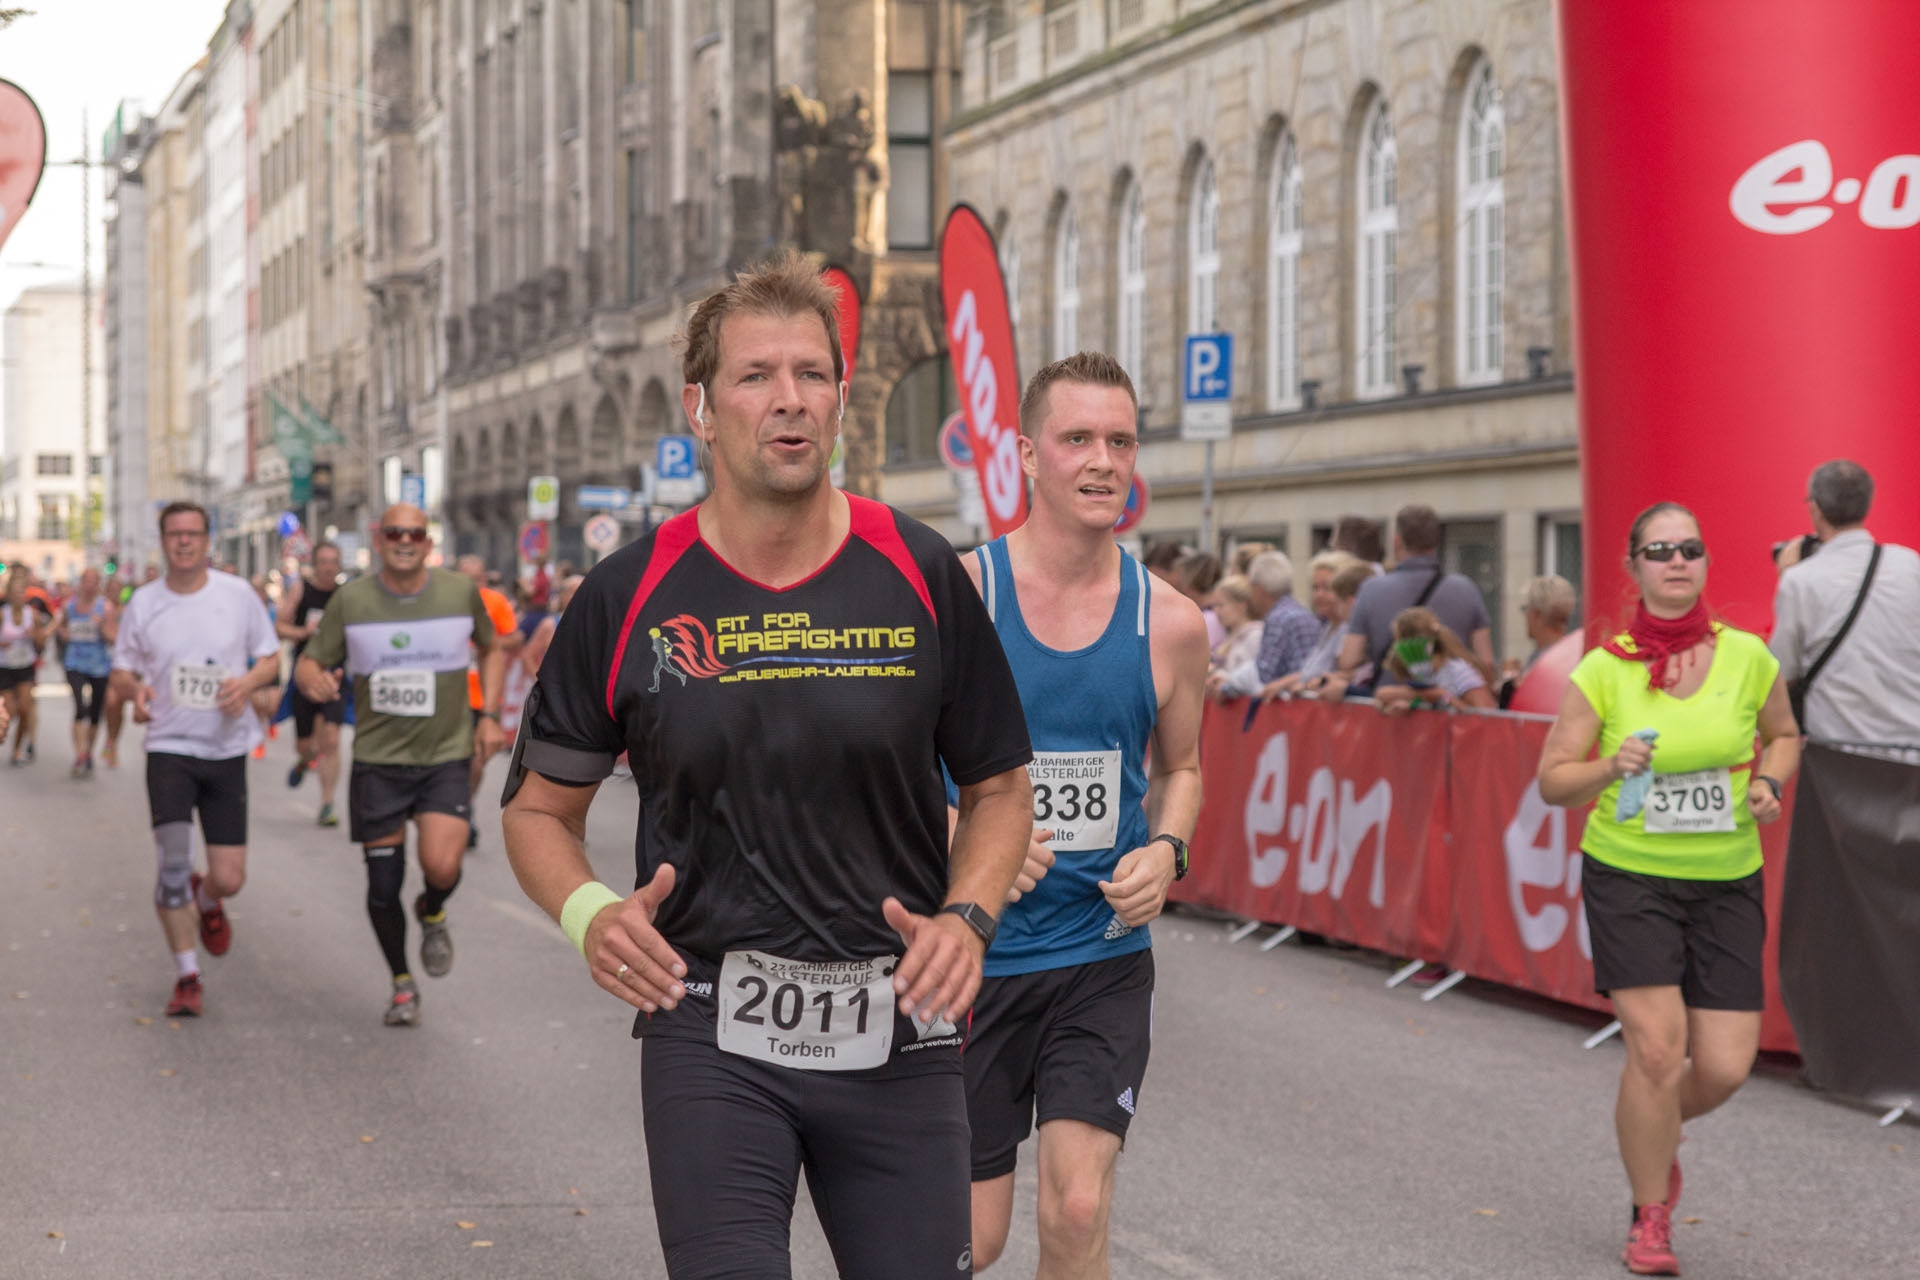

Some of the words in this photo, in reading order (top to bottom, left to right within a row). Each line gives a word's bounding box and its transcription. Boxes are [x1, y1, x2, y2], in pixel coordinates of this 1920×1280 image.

[1190, 340, 1220, 396] P
[661, 440, 687, 476] P
[716, 615, 750, 633] FIT
[763, 612, 811, 629] FOR
[718, 626, 915, 655] FIREFIGHTING
[1028, 767, 1104, 779] ALSTERLAUF
[1040, 757, 1084, 767] BARMER
[1086, 756, 1104, 766] GEK
[1654, 785, 1725, 813] 3709
[849, 958, 874, 972] GEK
[733, 975, 870, 1034] 2011
[767, 1036, 836, 1059] Torben
